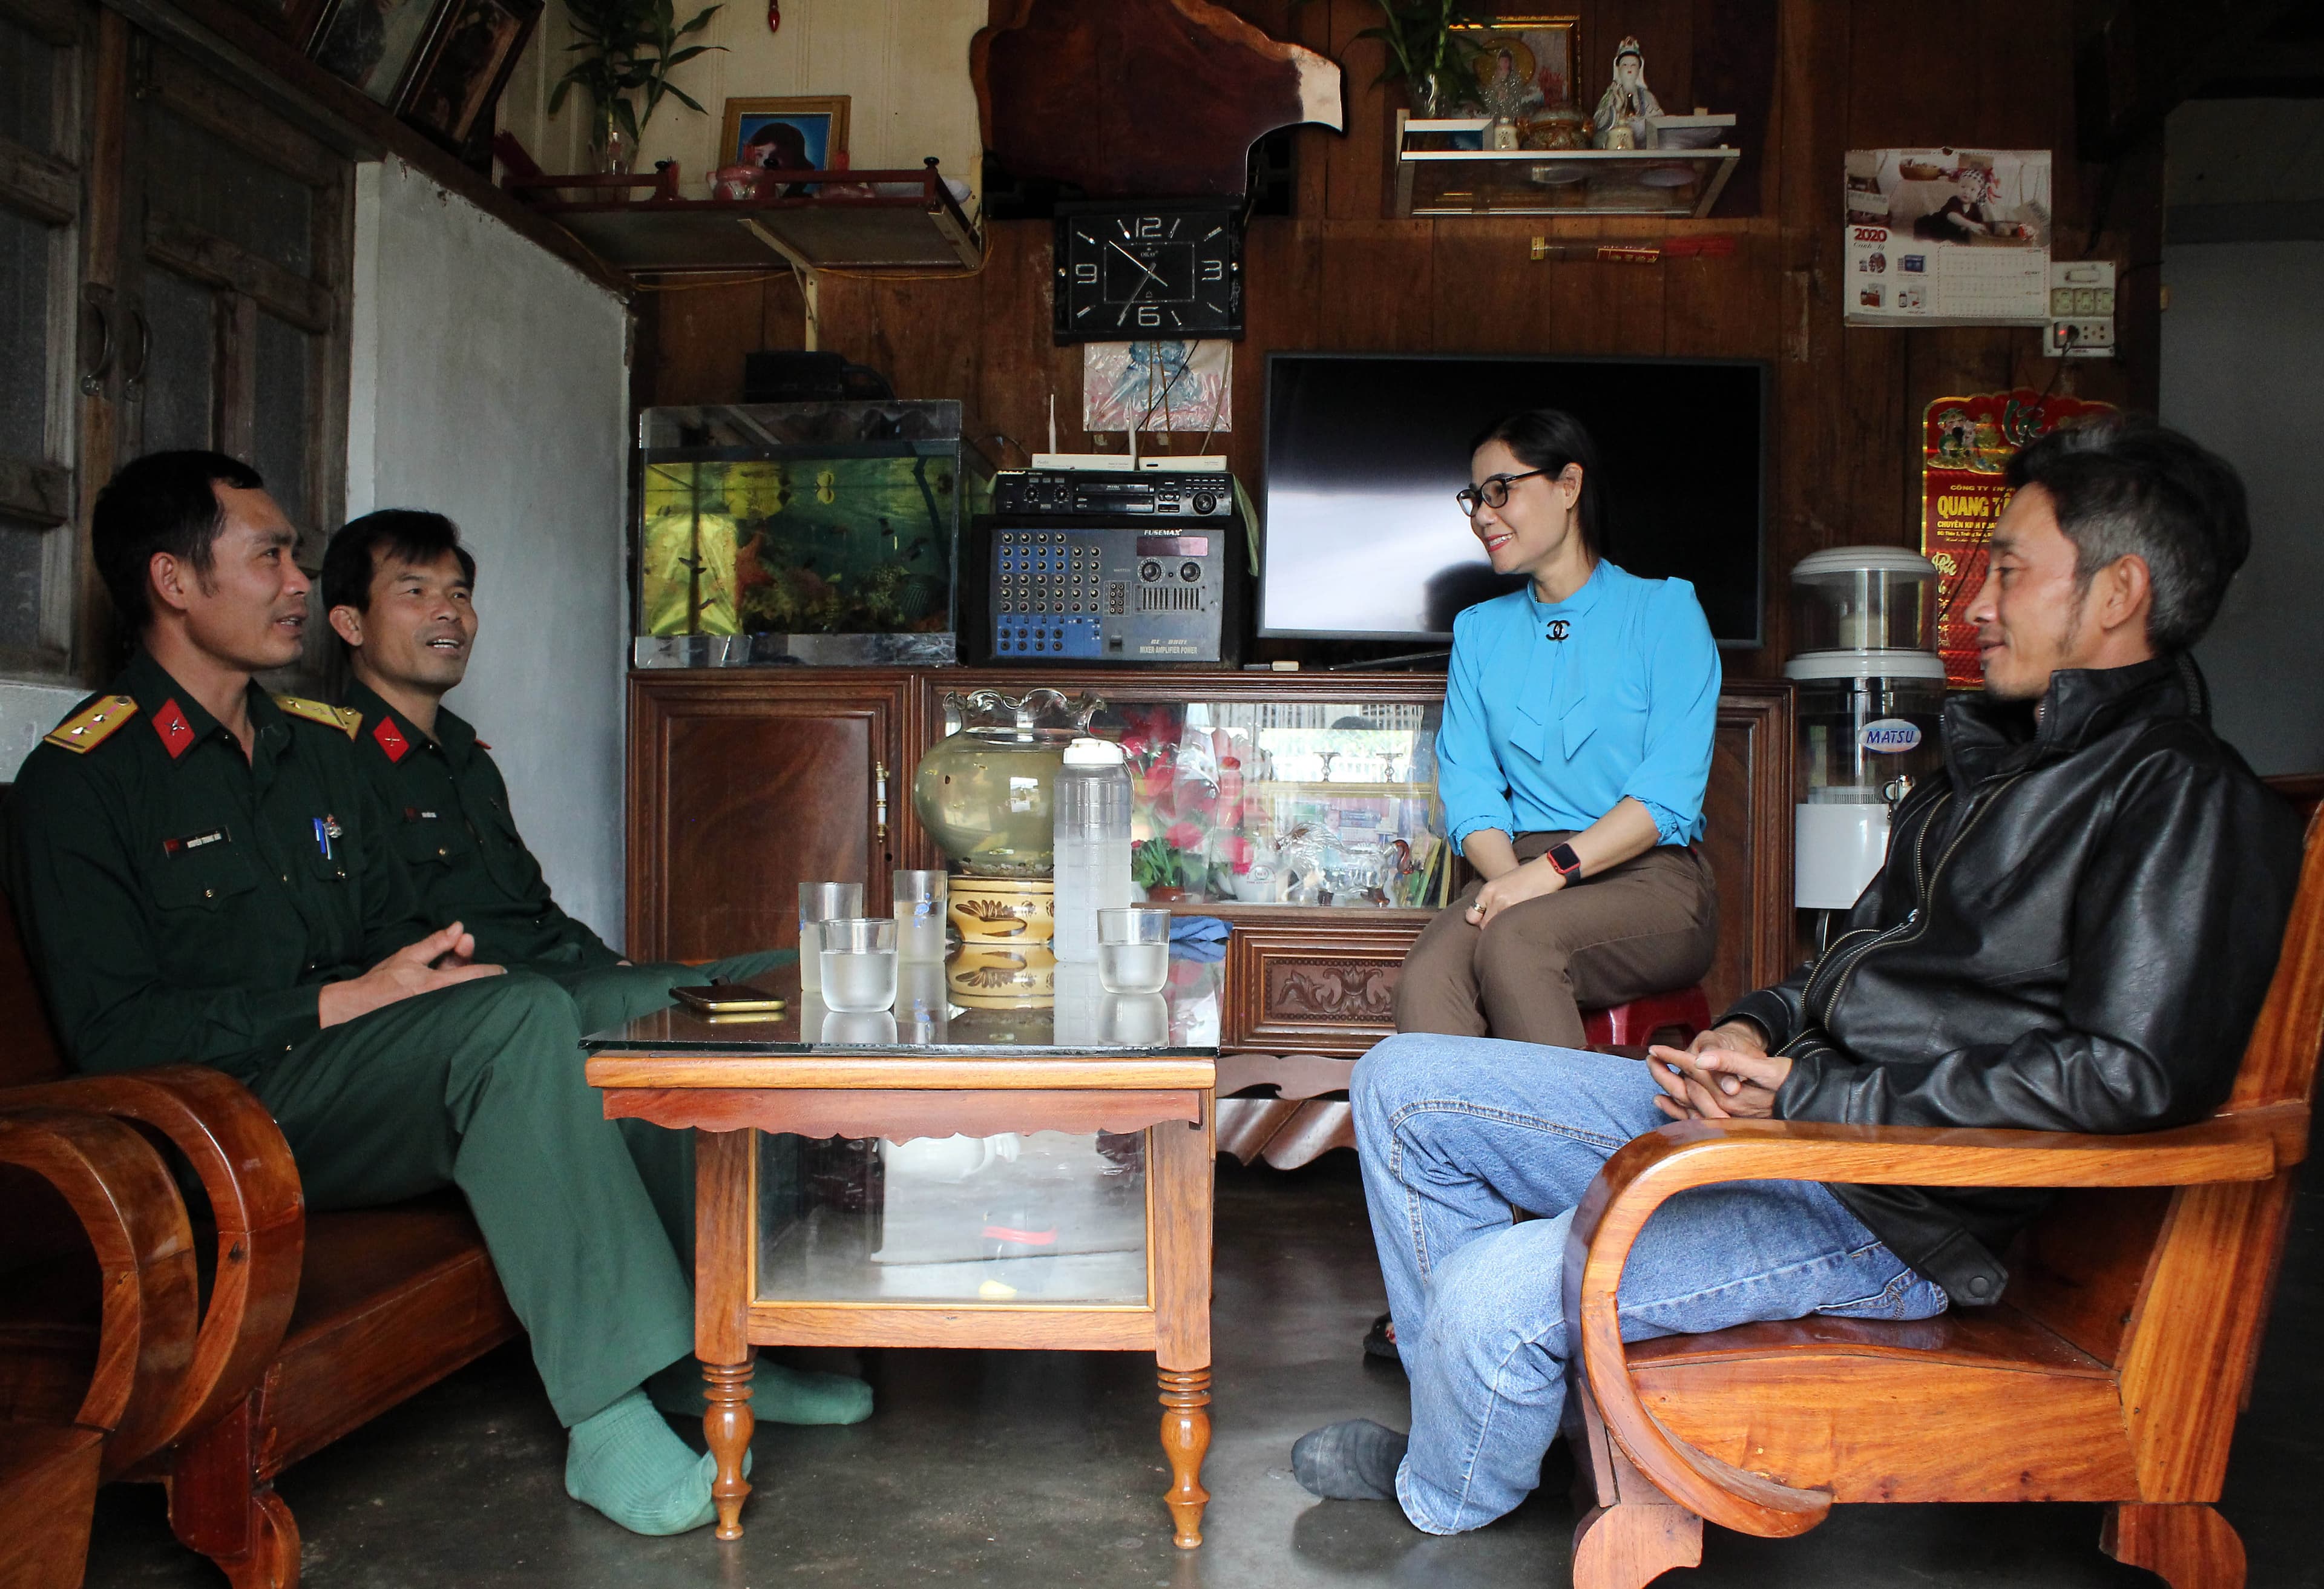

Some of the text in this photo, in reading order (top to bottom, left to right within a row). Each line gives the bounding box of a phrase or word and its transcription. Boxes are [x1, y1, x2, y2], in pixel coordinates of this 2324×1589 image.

[1135, 217, 1162, 237] 12
[1854, 228, 1887, 242] 2020
[1075, 263, 1098, 284] 9
[1201, 260, 1223, 281] 3
[1138, 306, 1160, 326] 6
[1937, 495, 1989, 519] QUANG
[1937, 520, 1963, 528] CHUYÊN
[1866, 730, 1914, 744] MATSU
